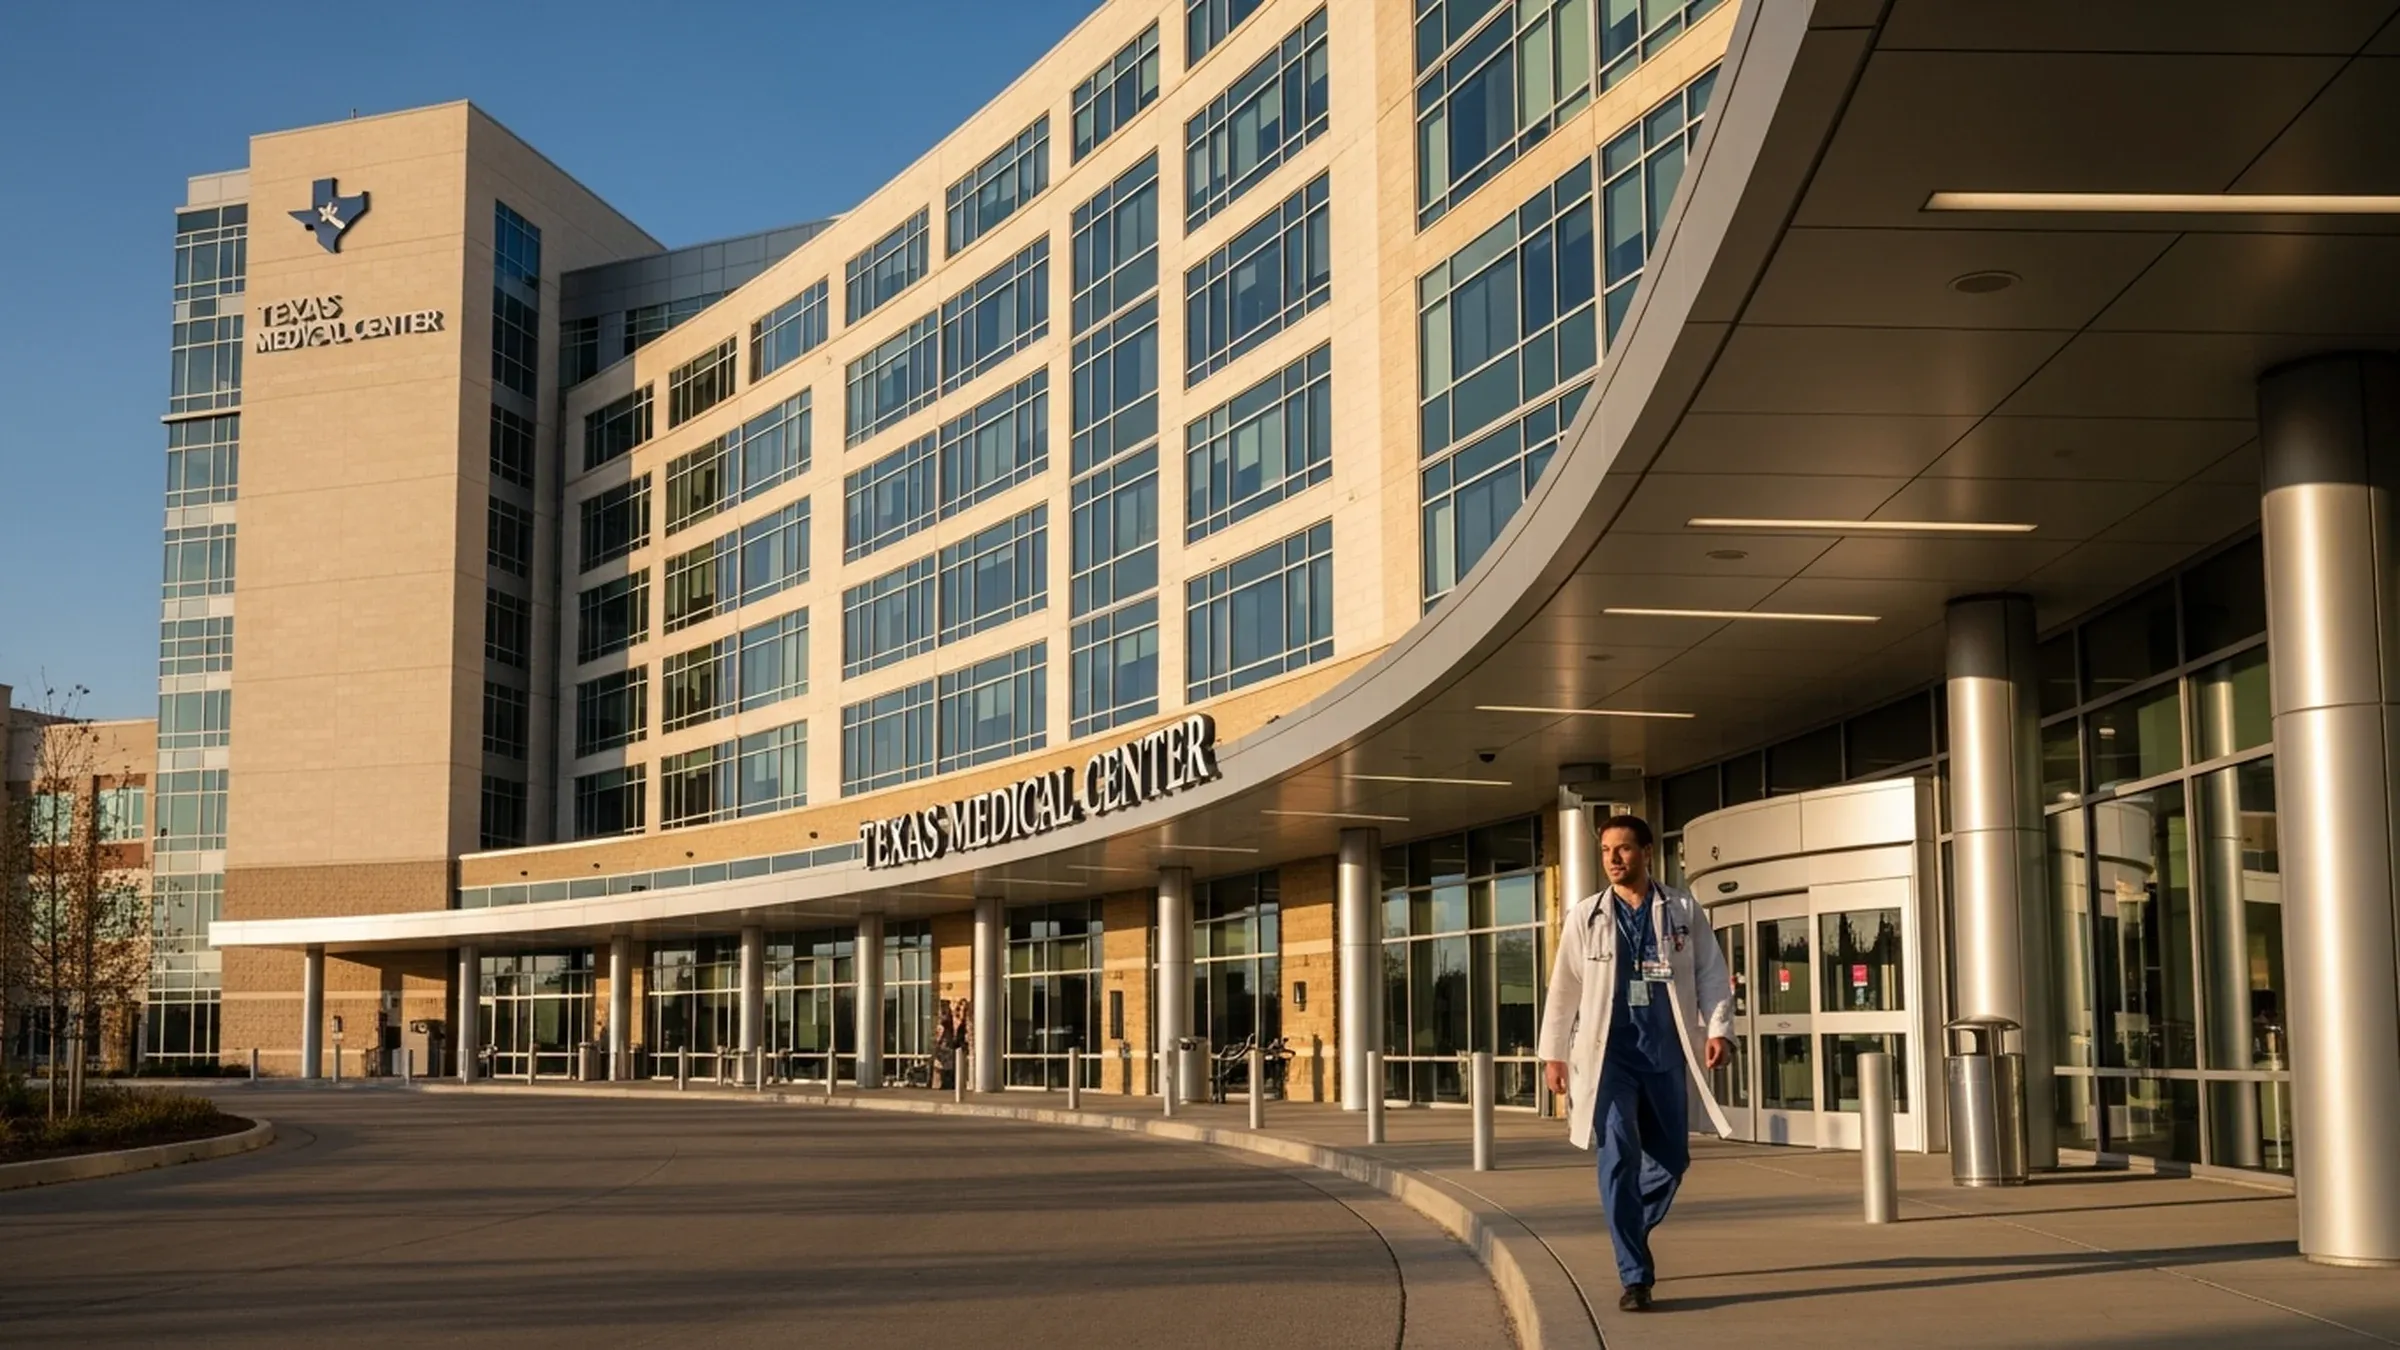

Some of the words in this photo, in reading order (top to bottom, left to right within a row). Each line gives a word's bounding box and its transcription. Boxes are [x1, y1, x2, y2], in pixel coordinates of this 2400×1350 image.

[256, 321, 354, 354] MEDICAL
[354, 309, 445, 341] CENTER
[257, 294, 344, 328] TEXAS
[859, 805, 944, 870] TEXAS
[945, 766, 1076, 853] MEDICAL
[1083, 712, 1214, 815] CENTER
